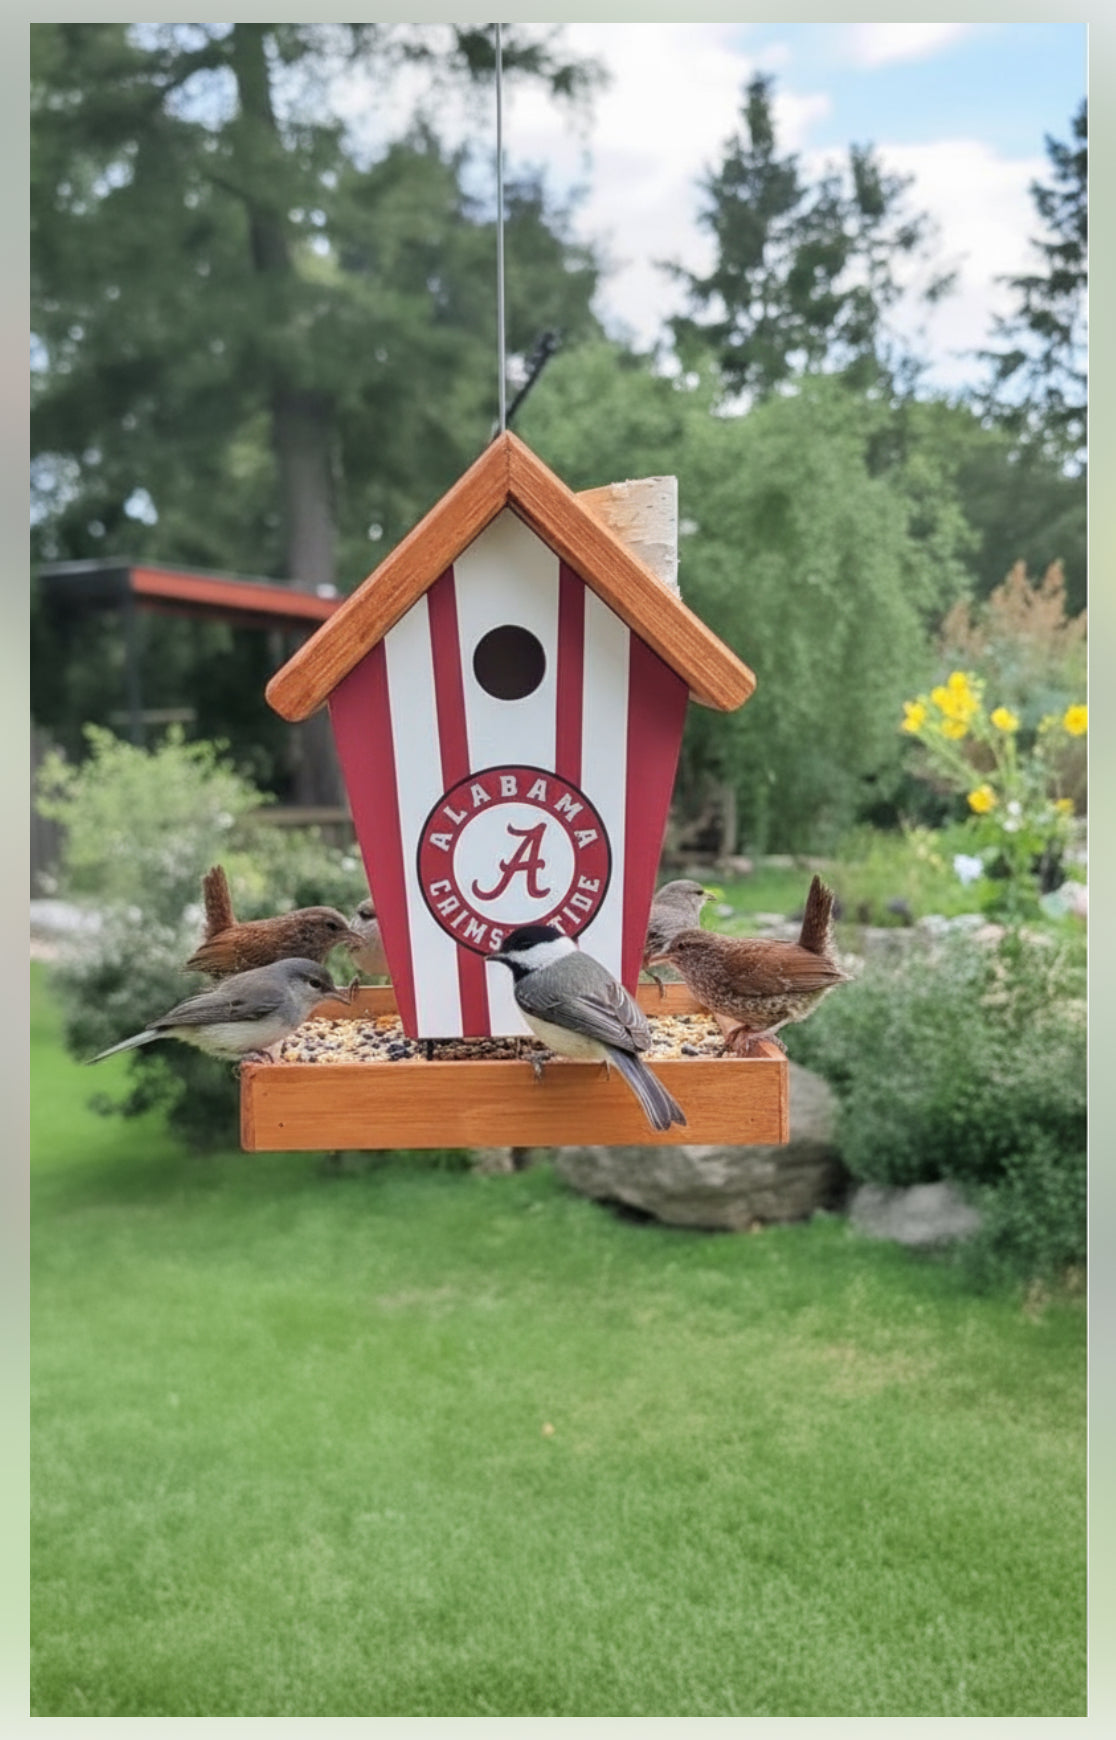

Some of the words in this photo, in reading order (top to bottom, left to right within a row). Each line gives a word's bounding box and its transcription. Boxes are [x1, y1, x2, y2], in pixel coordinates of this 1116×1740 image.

[429, 775, 598, 852] ALABAMA
[471, 822, 551, 900] A
[429, 879, 512, 950] CRIMS
[546, 875, 600, 935] TIDE
